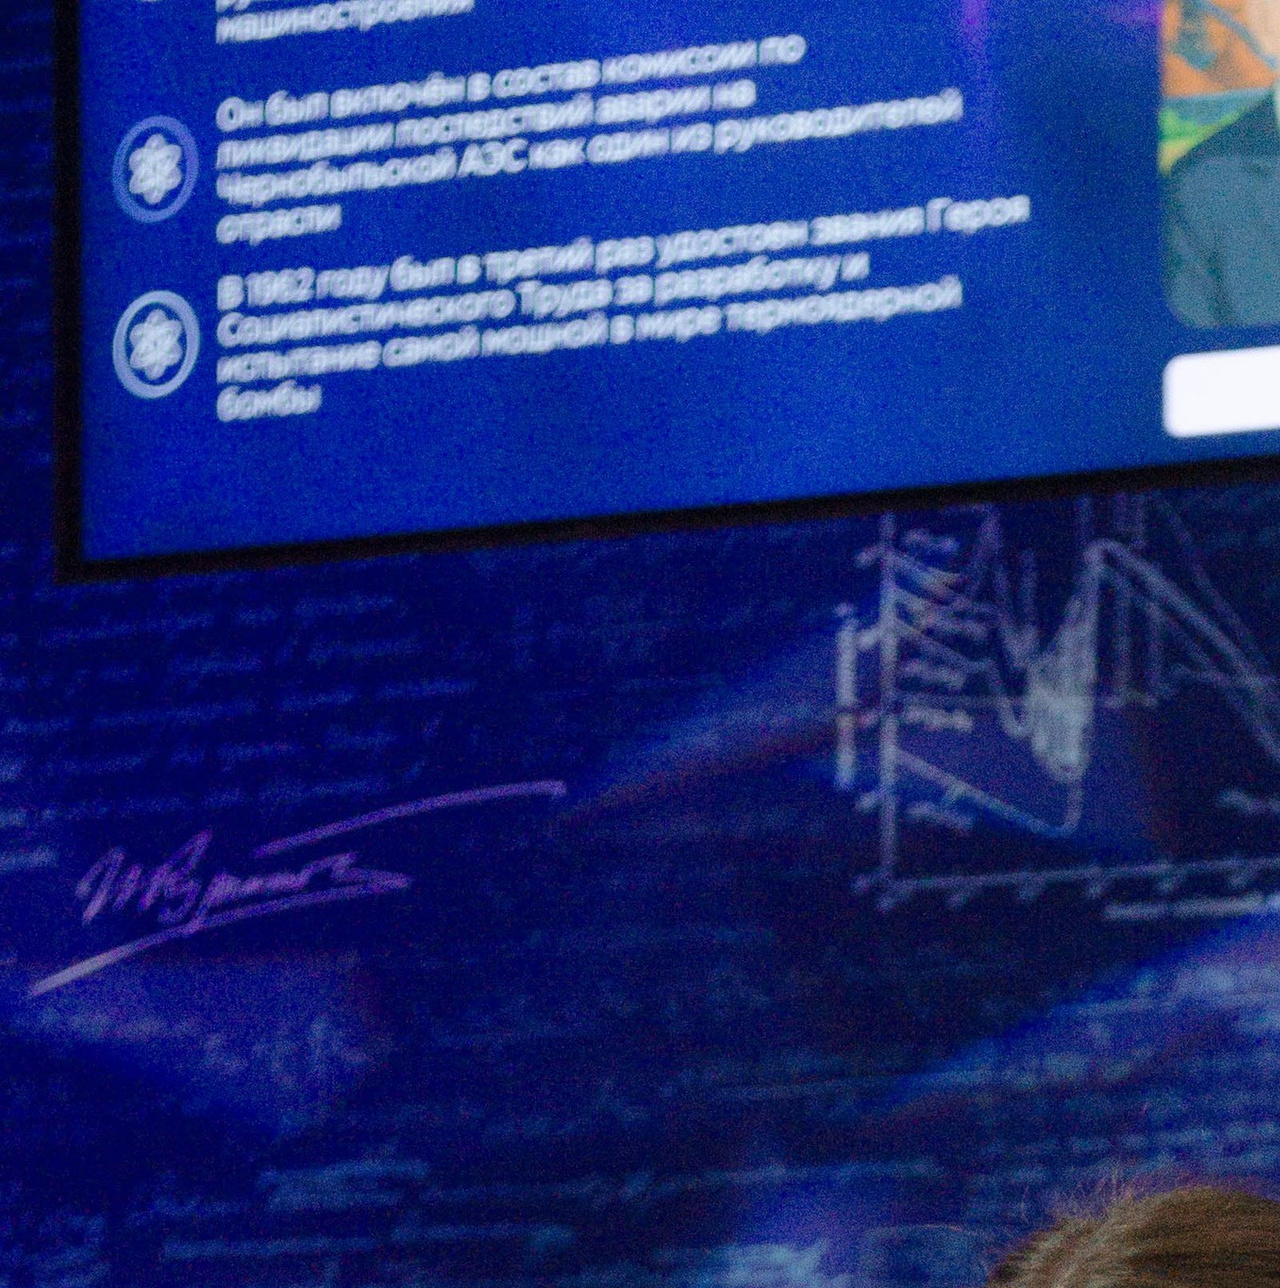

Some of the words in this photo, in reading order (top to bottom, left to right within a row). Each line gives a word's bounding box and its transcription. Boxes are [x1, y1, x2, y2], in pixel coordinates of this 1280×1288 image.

[216, 97, 263, 131] Он
[265, 91, 328, 125] был
[331, 72, 465, 118] включён
[467, 73, 491, 101] в
[493, 60, 600, 98] состав
[602, 41, 757, 83] комиссии
[759, 35, 806, 64] по
[216, 123, 394, 168] ликвидации
[396, 94, 594, 146] последствий
[595, 86, 711, 125] аварии
[713, 80, 756, 109] на
[216, 148, 456, 205] Чернобыльской
[457, 139, 528, 177] АЭС
[529, 138, 585, 168] как
[587, 129, 669, 163] один
[671, 123, 712, 153] из
[714, 88, 963, 154] руководителей
[216, 205, 341, 244] отрасли
[217, 275, 243, 310] В
[316, 267, 389, 298] году
[391, 256, 455, 291] был
[457, 255, 480, 284] в
[483, 237, 593, 283] третий
[596, 236, 654, 273] раз
[656, 221, 808, 267] удостоен
[811, 207, 924, 245] звания
[927, 195, 1030, 233] Героя
[217, 290, 515, 346] Социалистического
[517, 279, 612, 317] Труда
[615, 275, 652, 305] за
[655, 255, 841, 304] разработку
[843, 253, 869, 280] и
[217, 341, 381, 382] испытание
[383, 326, 479, 366] самой
[482, 313, 608, 355] мощной
[611, 315, 634, 344] в
[636, 306, 723, 341] мире
[724, 276, 962, 332] термоядерной
[217, 381, 321, 421] бомбы
